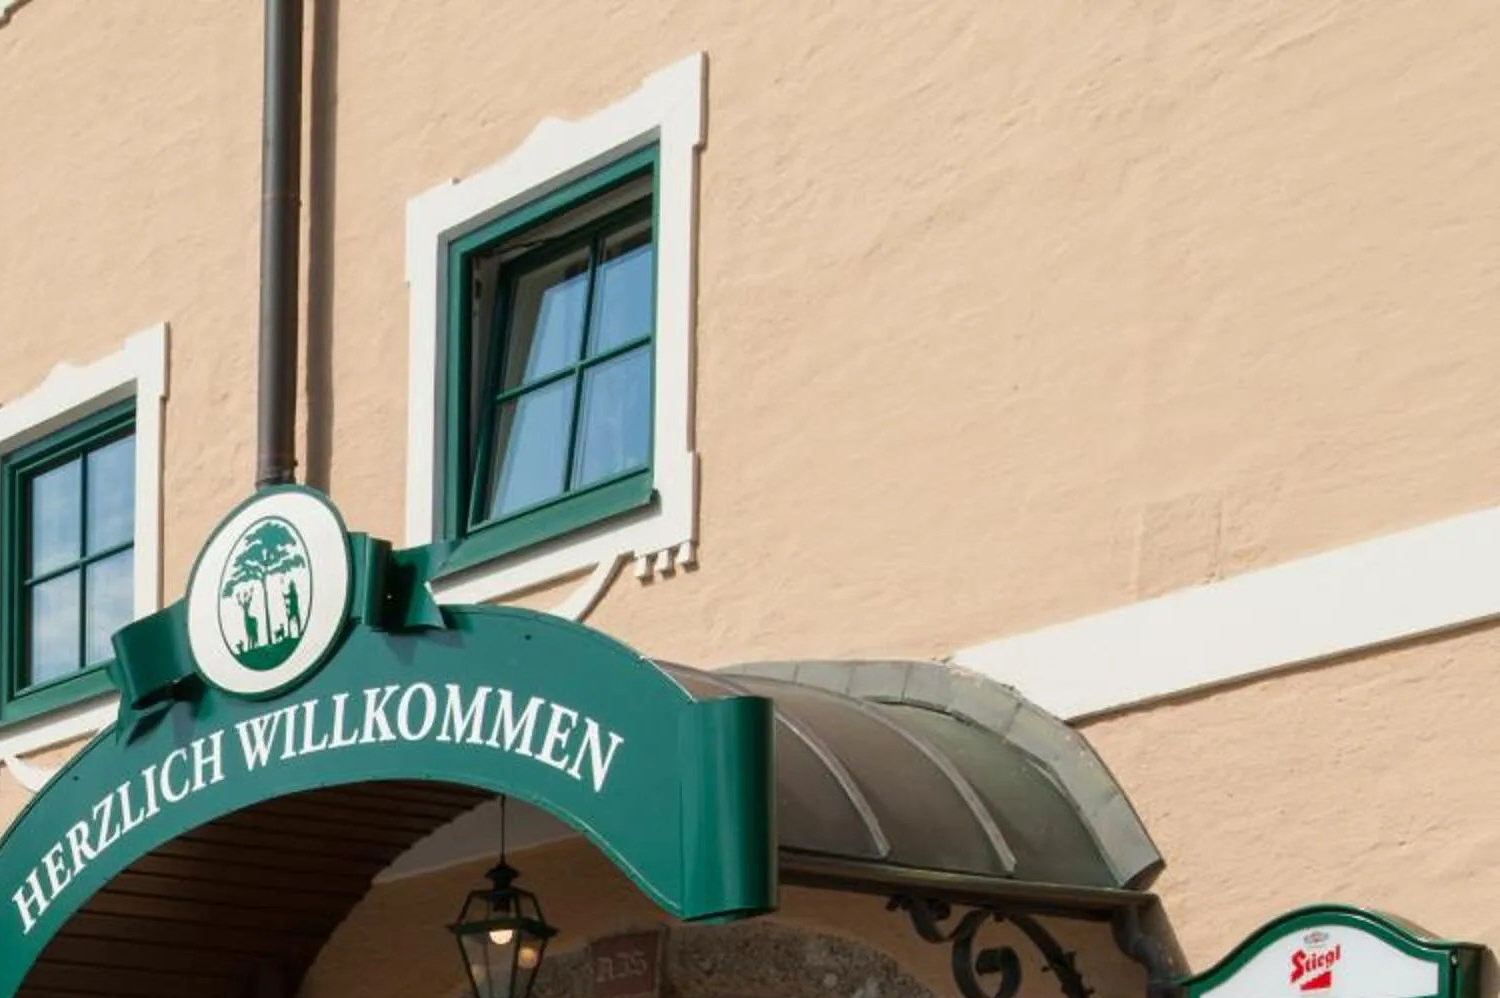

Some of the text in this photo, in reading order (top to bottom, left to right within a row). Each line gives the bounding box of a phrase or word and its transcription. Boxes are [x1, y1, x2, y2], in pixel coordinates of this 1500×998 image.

[11, 681, 624, 934] HERZLICH WILLKOMMEN
[1290, 944, 1341, 983] Stiegl
